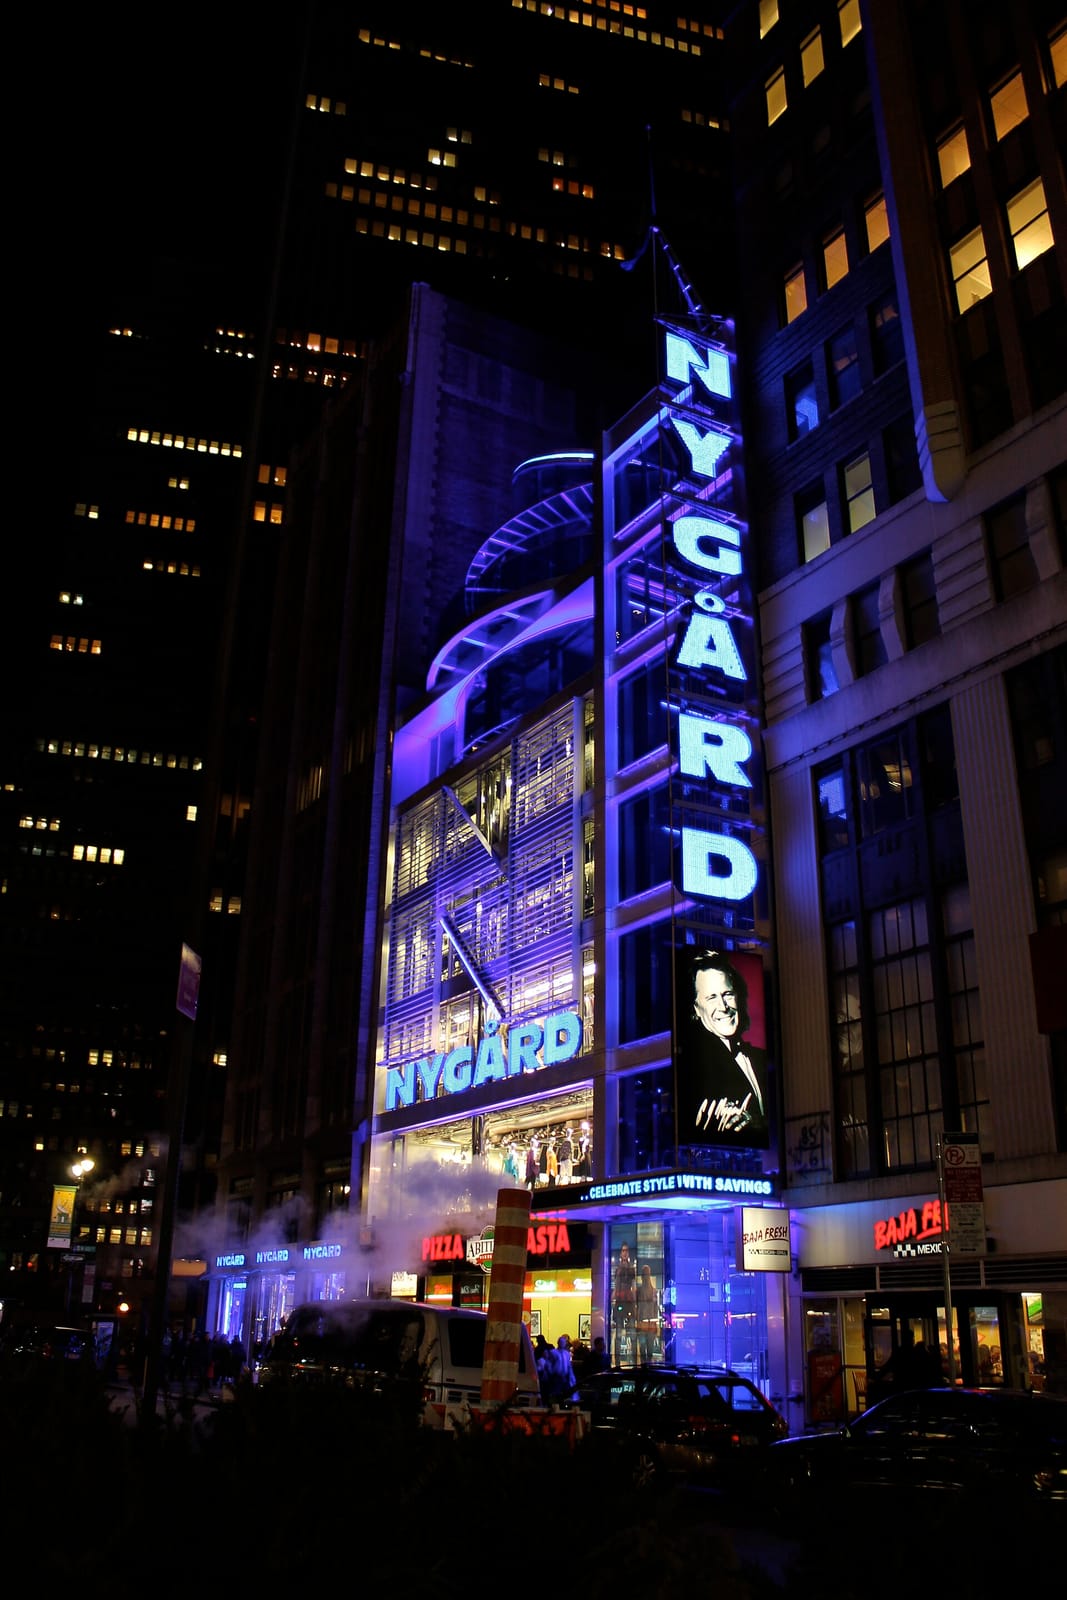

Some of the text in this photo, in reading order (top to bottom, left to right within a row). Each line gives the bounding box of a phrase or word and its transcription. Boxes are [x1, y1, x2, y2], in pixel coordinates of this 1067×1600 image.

[665, 331, 758, 902] NYGÅRD
[384, 1012, 583, 1111] NYGÅRD
[643, 1176, 675, 1193] STYLE
[714, 1177, 772, 1195] SAVINGS
[526, 1224, 571, 1255] ASTA
[743, 1226, 788, 1245] BAJA FRESH
[873, 1207, 918, 1251] BAJA
[422, 1234, 464, 1262] PIZZA
[917, 1242, 951, 1256] MEXIC
